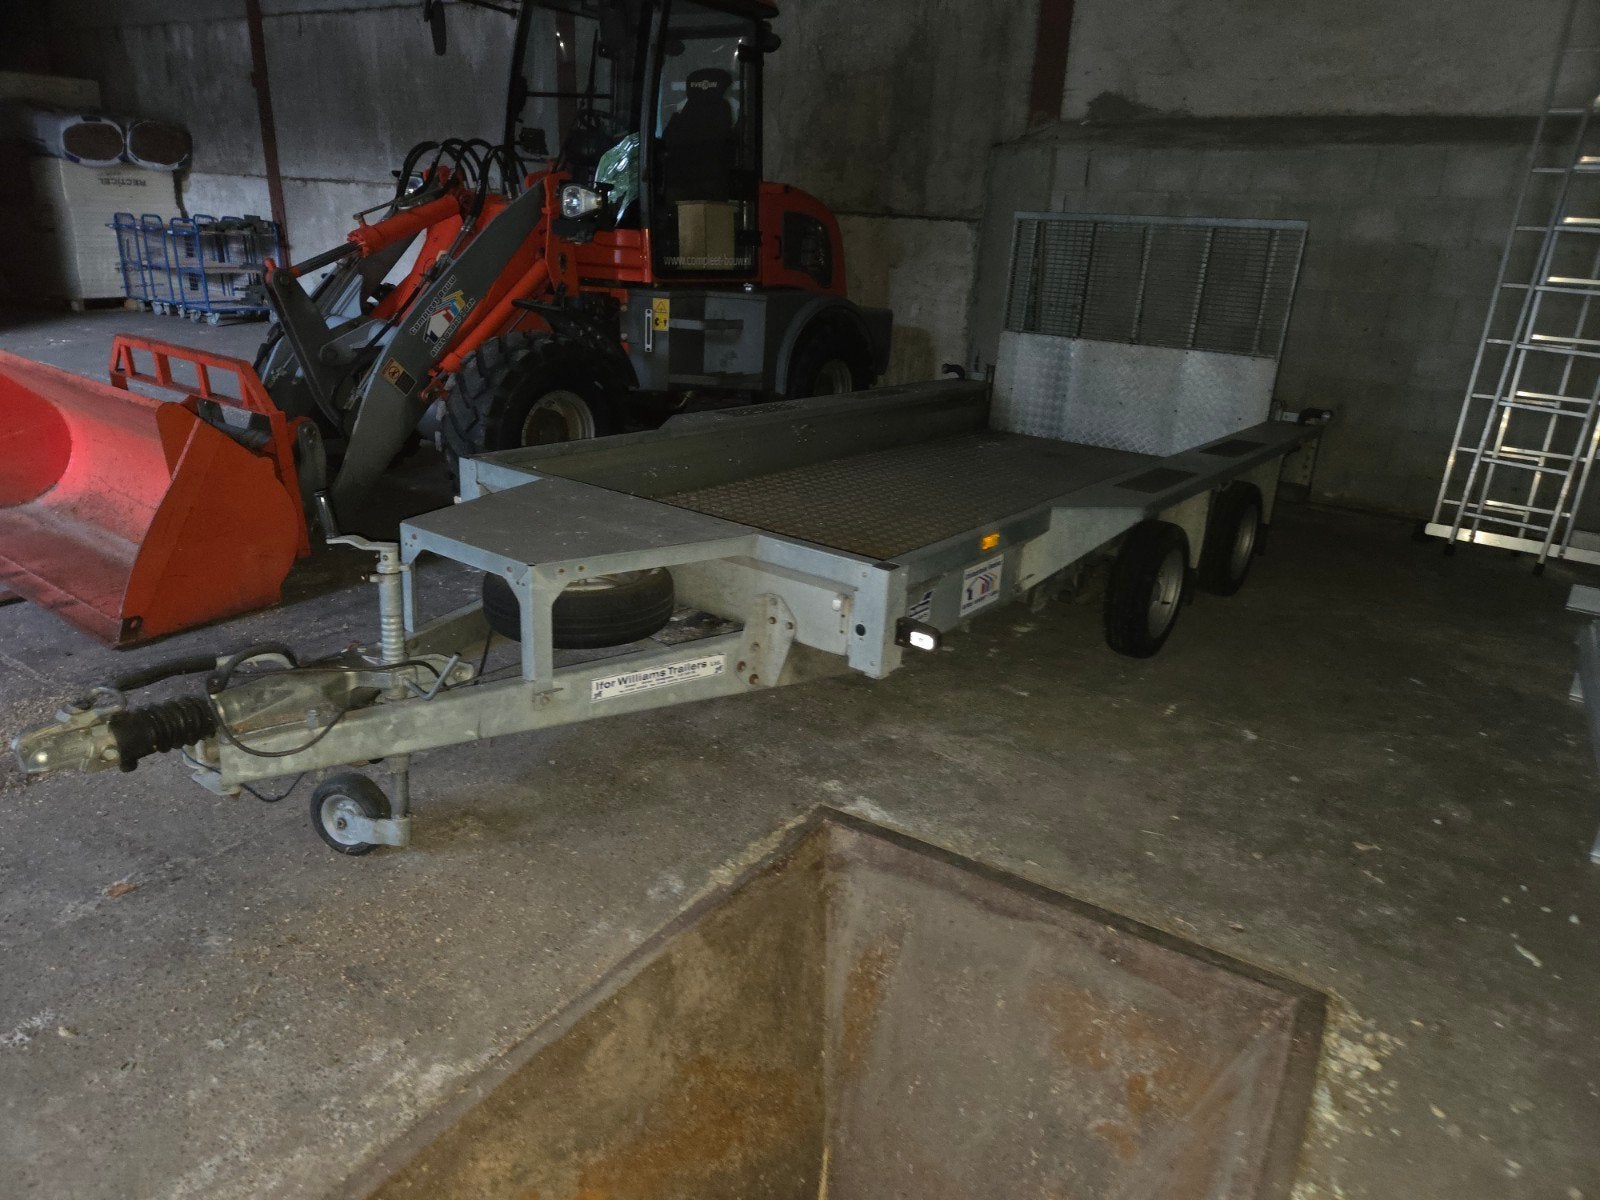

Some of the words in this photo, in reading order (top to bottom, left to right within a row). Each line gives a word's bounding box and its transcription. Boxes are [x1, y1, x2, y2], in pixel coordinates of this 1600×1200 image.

[98, 178, 146, 187] RECTICEL
[596, 680, 616, 691] Ifor
[618, 671, 667, 686] Williams
[668, 662, 707, 675] Trailers
